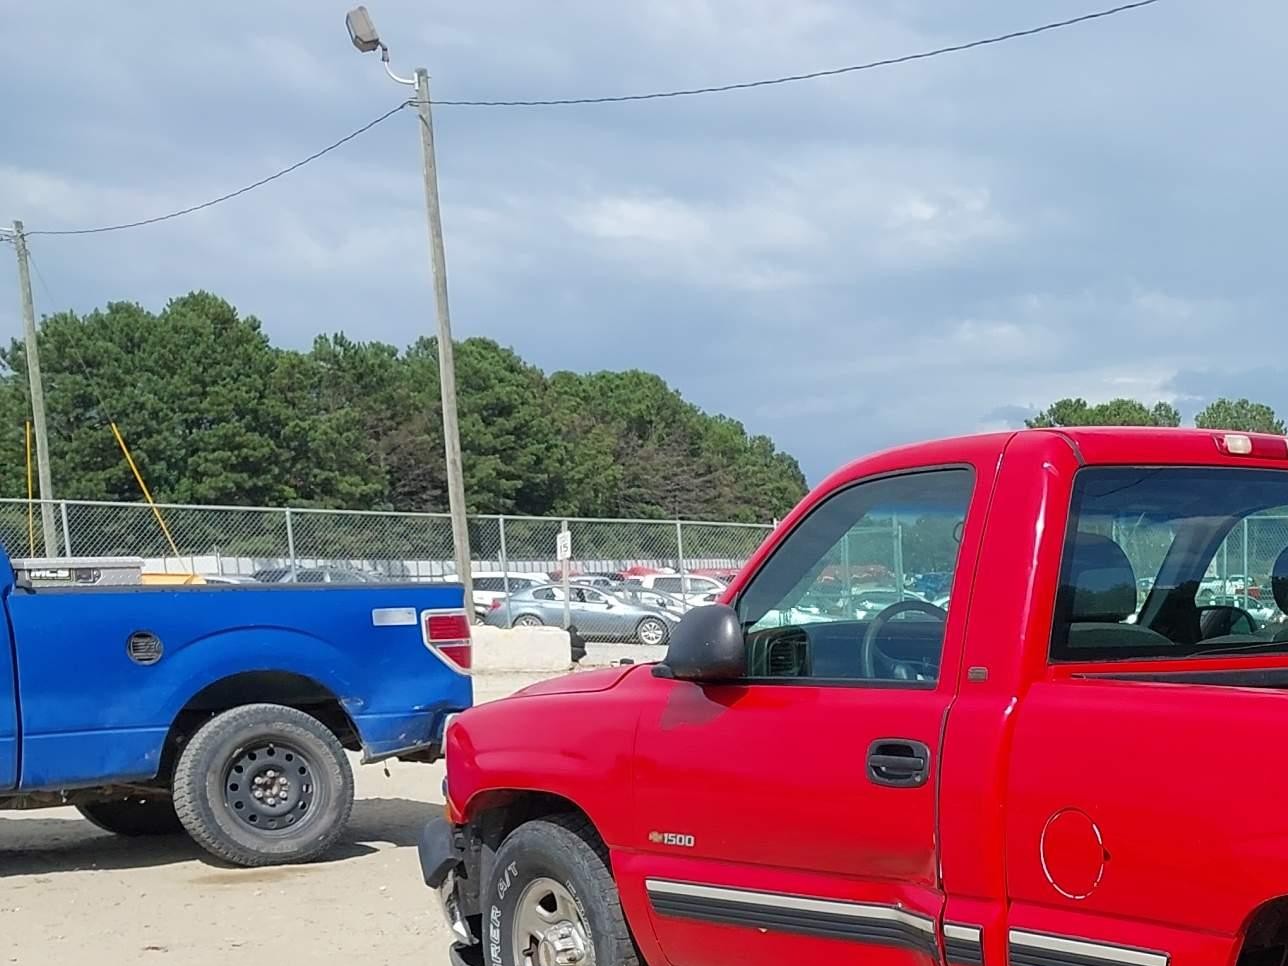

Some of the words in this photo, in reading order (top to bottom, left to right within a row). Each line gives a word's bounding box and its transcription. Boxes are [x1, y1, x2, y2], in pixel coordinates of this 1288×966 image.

[560, 543, 569, 553] 15
[663, 832, 695, 847] 1500
[498, 861, 518, 899] A/T
